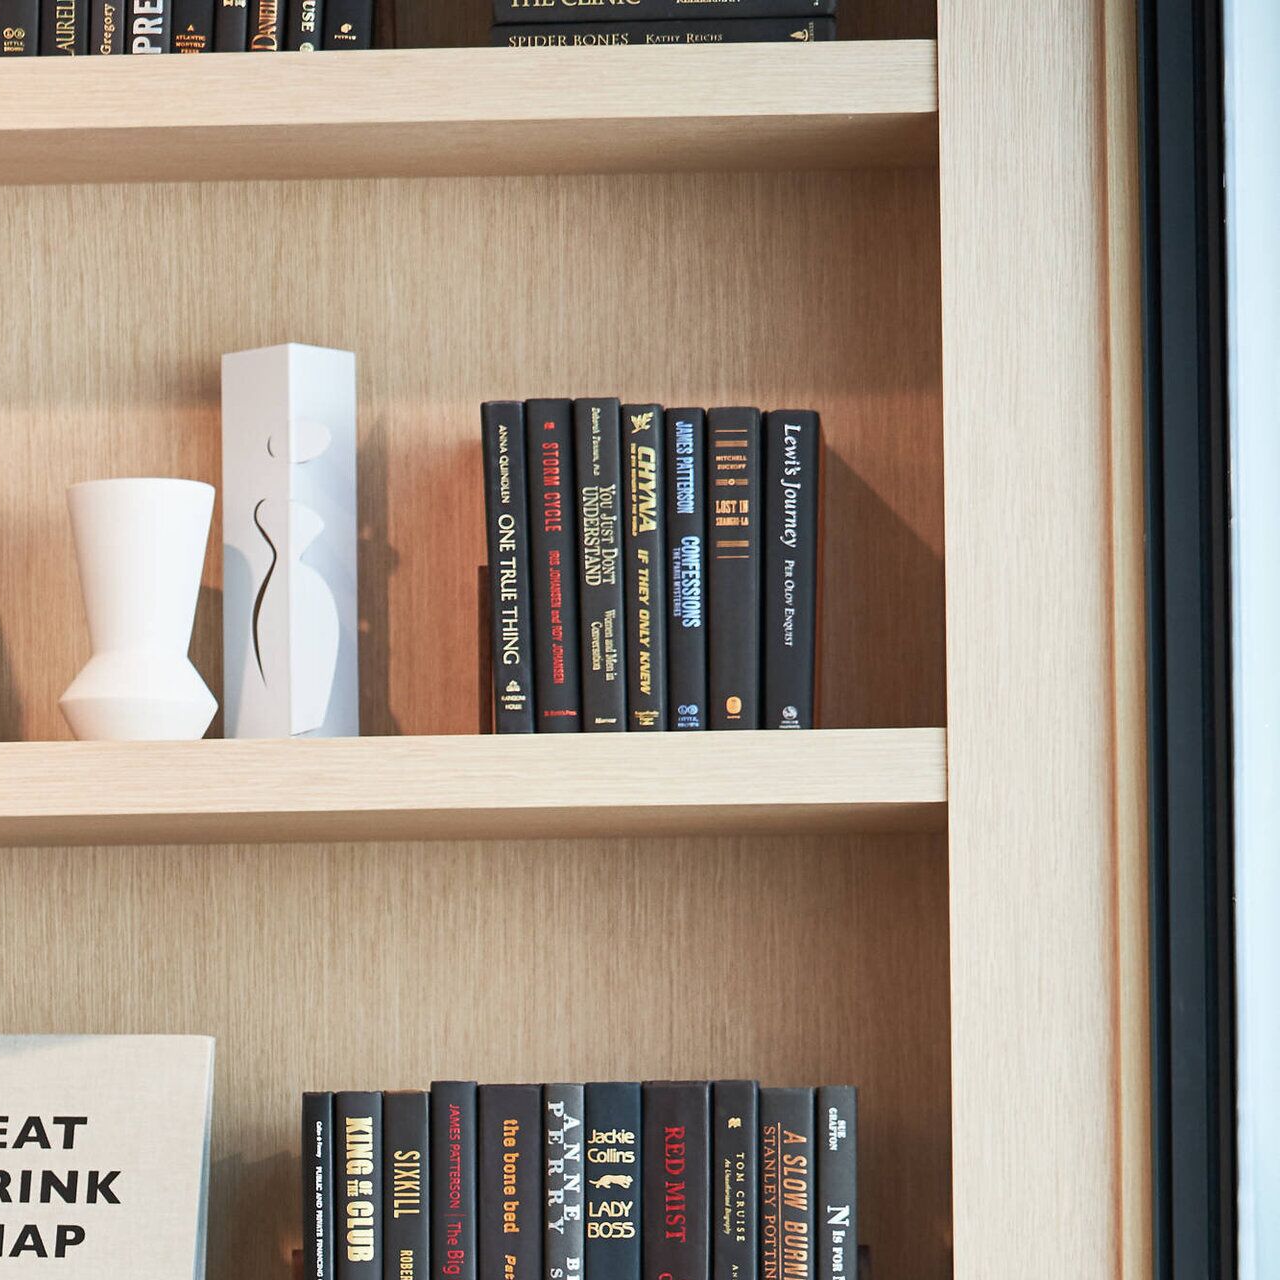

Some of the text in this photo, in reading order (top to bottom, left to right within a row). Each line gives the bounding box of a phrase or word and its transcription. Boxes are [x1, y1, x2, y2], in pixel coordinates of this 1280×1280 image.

[101, 3, 115, 55] Gregory
[509, 33, 629, 47] SPIDER BONES
[498, 425, 510, 503] ANNA QUINDLEN
[542, 442, 561, 532] STORM CYCLE
[638, 446, 656, 532] CHYNA
[676, 421, 694, 513] JAMES PATTERSON
[780, 424, 801, 547] Lewi's Journey
[498, 514, 519, 664] ONE TRUE THING
[638, 549, 650, 695] IF THEY ONLY KNEW
[681, 536, 700, 627] CONFESSIONS
[503, 1119, 520, 1233] the bone bed
[548, 1101, 564, 1234] PERRY
[563, 1113, 580, 1221] ANNE
[587, 1149, 635, 1163] Collins
[588, 1129, 635, 1144] Jackie
[763, 1126, 776, 1206] STANLEY
[783, 1131, 806, 1144] A
[345, 1117, 374, 1262] KING OF THE CLUB
[393, 1150, 420, 1218] SIXKILL
[588, 1202, 633, 1217] LADY
[664, 1126, 686, 1242] RED MIST
[736, 1153, 745, 1242] TOM CRUISE
[783, 1154, 807, 1211] SLOW
[443, 1250, 464, 1273] Big
[447, 1222, 463, 1245] The
[588, 1222, 635, 1239] BOSS
